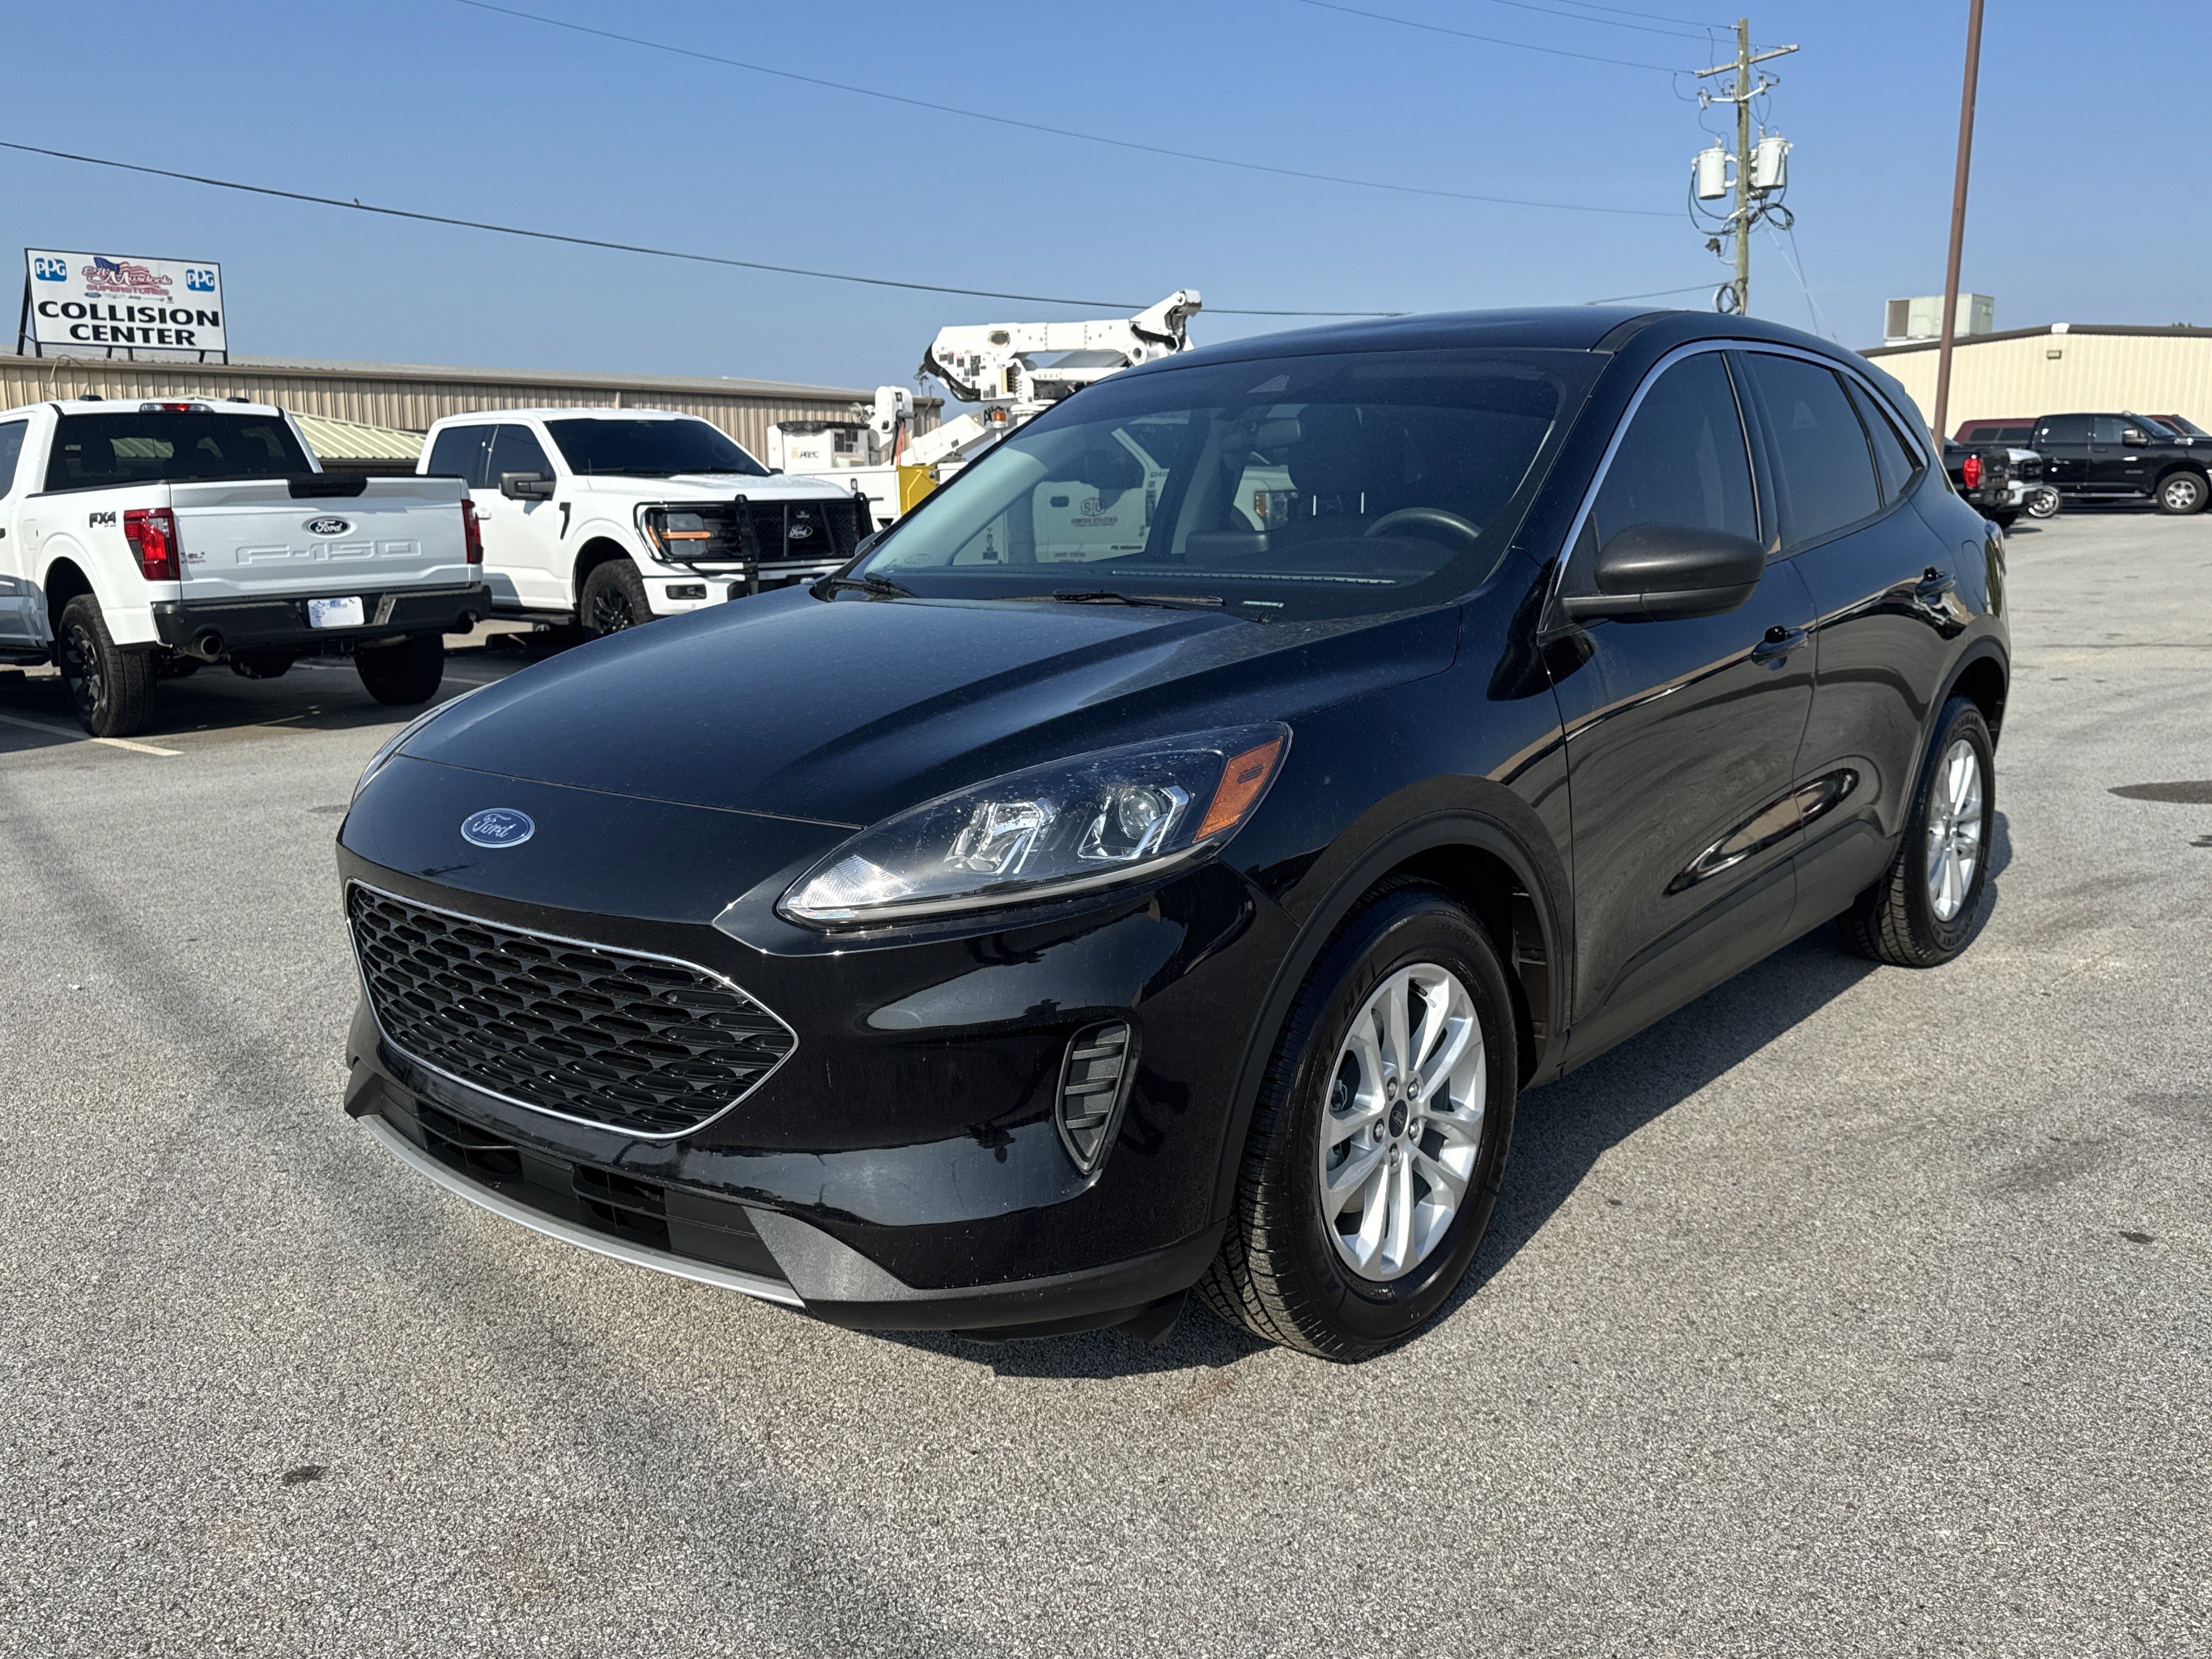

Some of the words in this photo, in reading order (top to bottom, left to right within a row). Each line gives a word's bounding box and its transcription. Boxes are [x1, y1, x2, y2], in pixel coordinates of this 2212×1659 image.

[36, 258, 66, 278] PPG
[187, 269, 215, 288] PPG
[38, 301, 219, 327] COLLISION
[70, 324, 196, 346] CENTER
[89, 511, 116, 528] FX4
[315, 521, 343, 533] Ford
[235, 539, 421, 565] F-150
[472, 813, 517, 838] Ford
